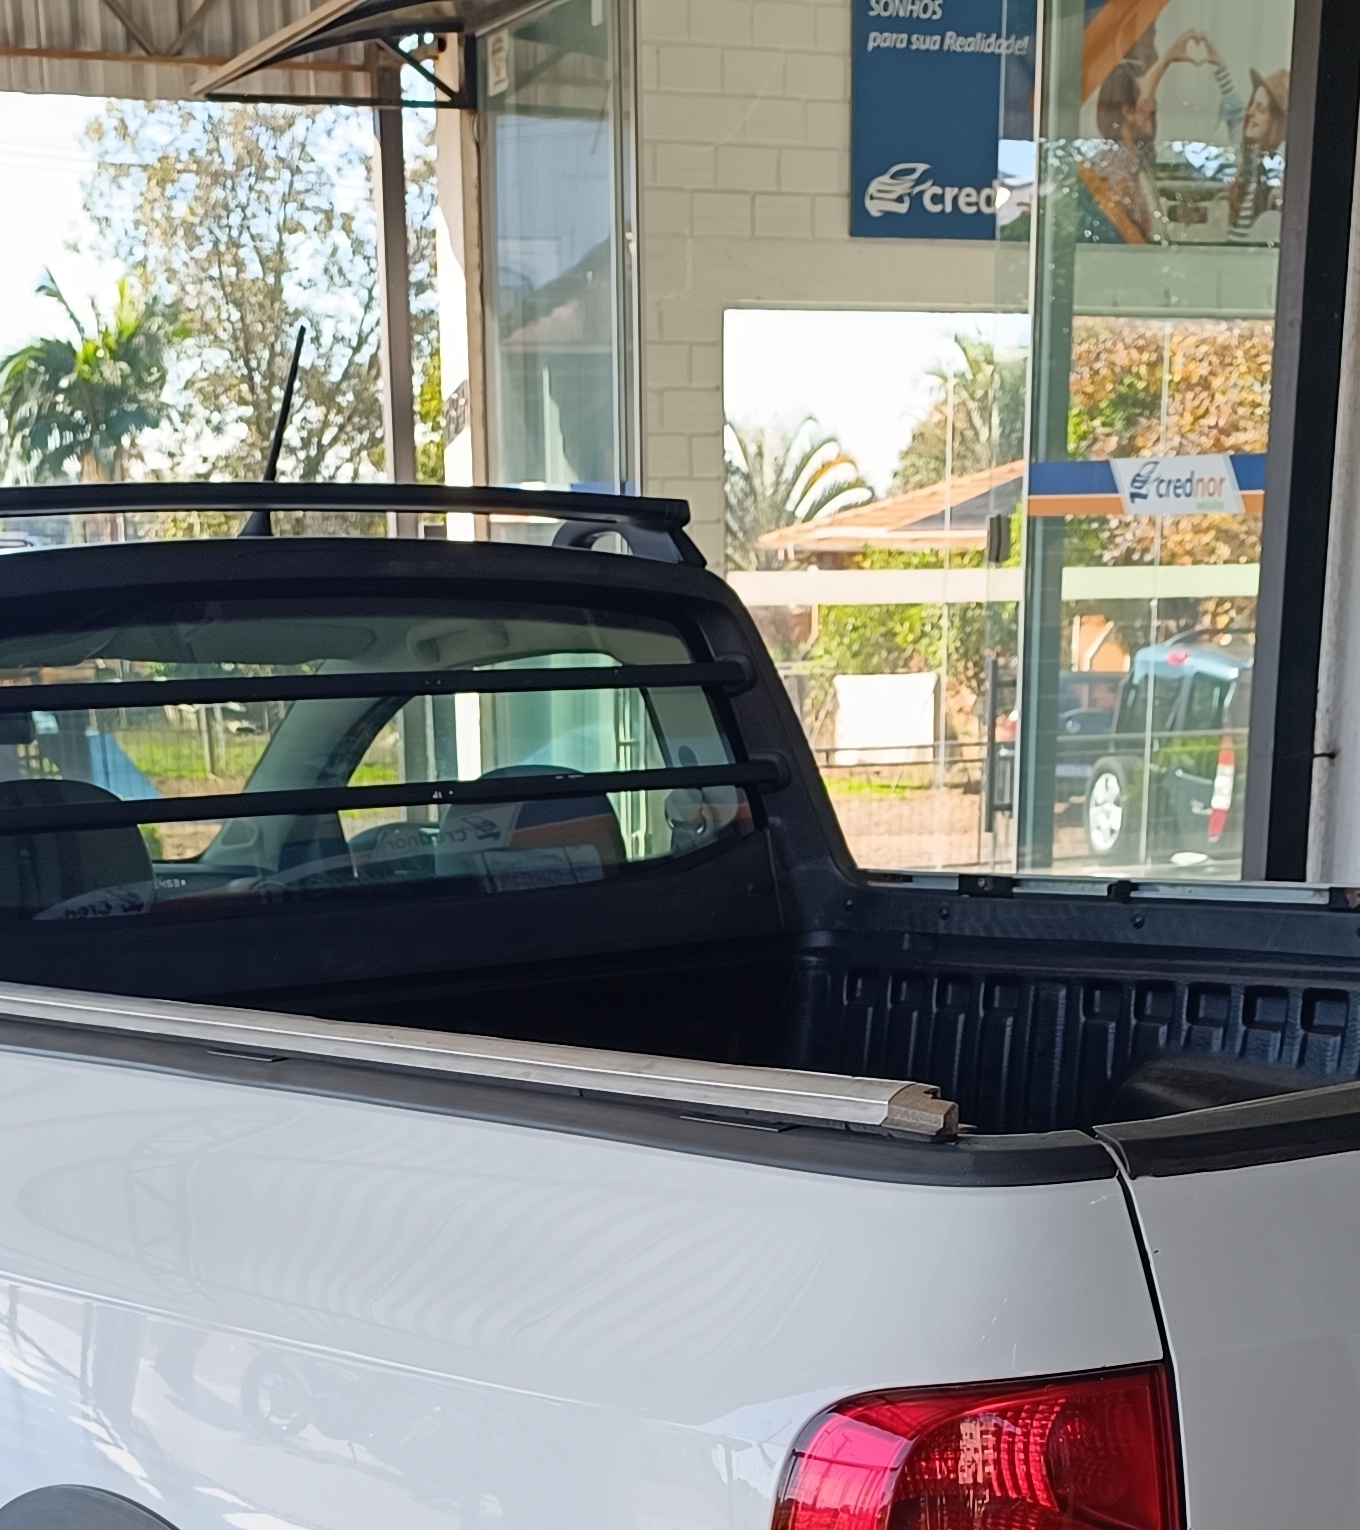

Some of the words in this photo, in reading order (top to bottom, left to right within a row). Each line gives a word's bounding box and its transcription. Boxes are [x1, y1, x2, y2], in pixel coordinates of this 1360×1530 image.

[868, 0, 943, 20] SONHOS
[867, 32, 908, 53] para
[910, 34, 941, 51] sua
[943, 31, 1030, 56] Realidade!
[1155, 470, 1227, 499] crednor
